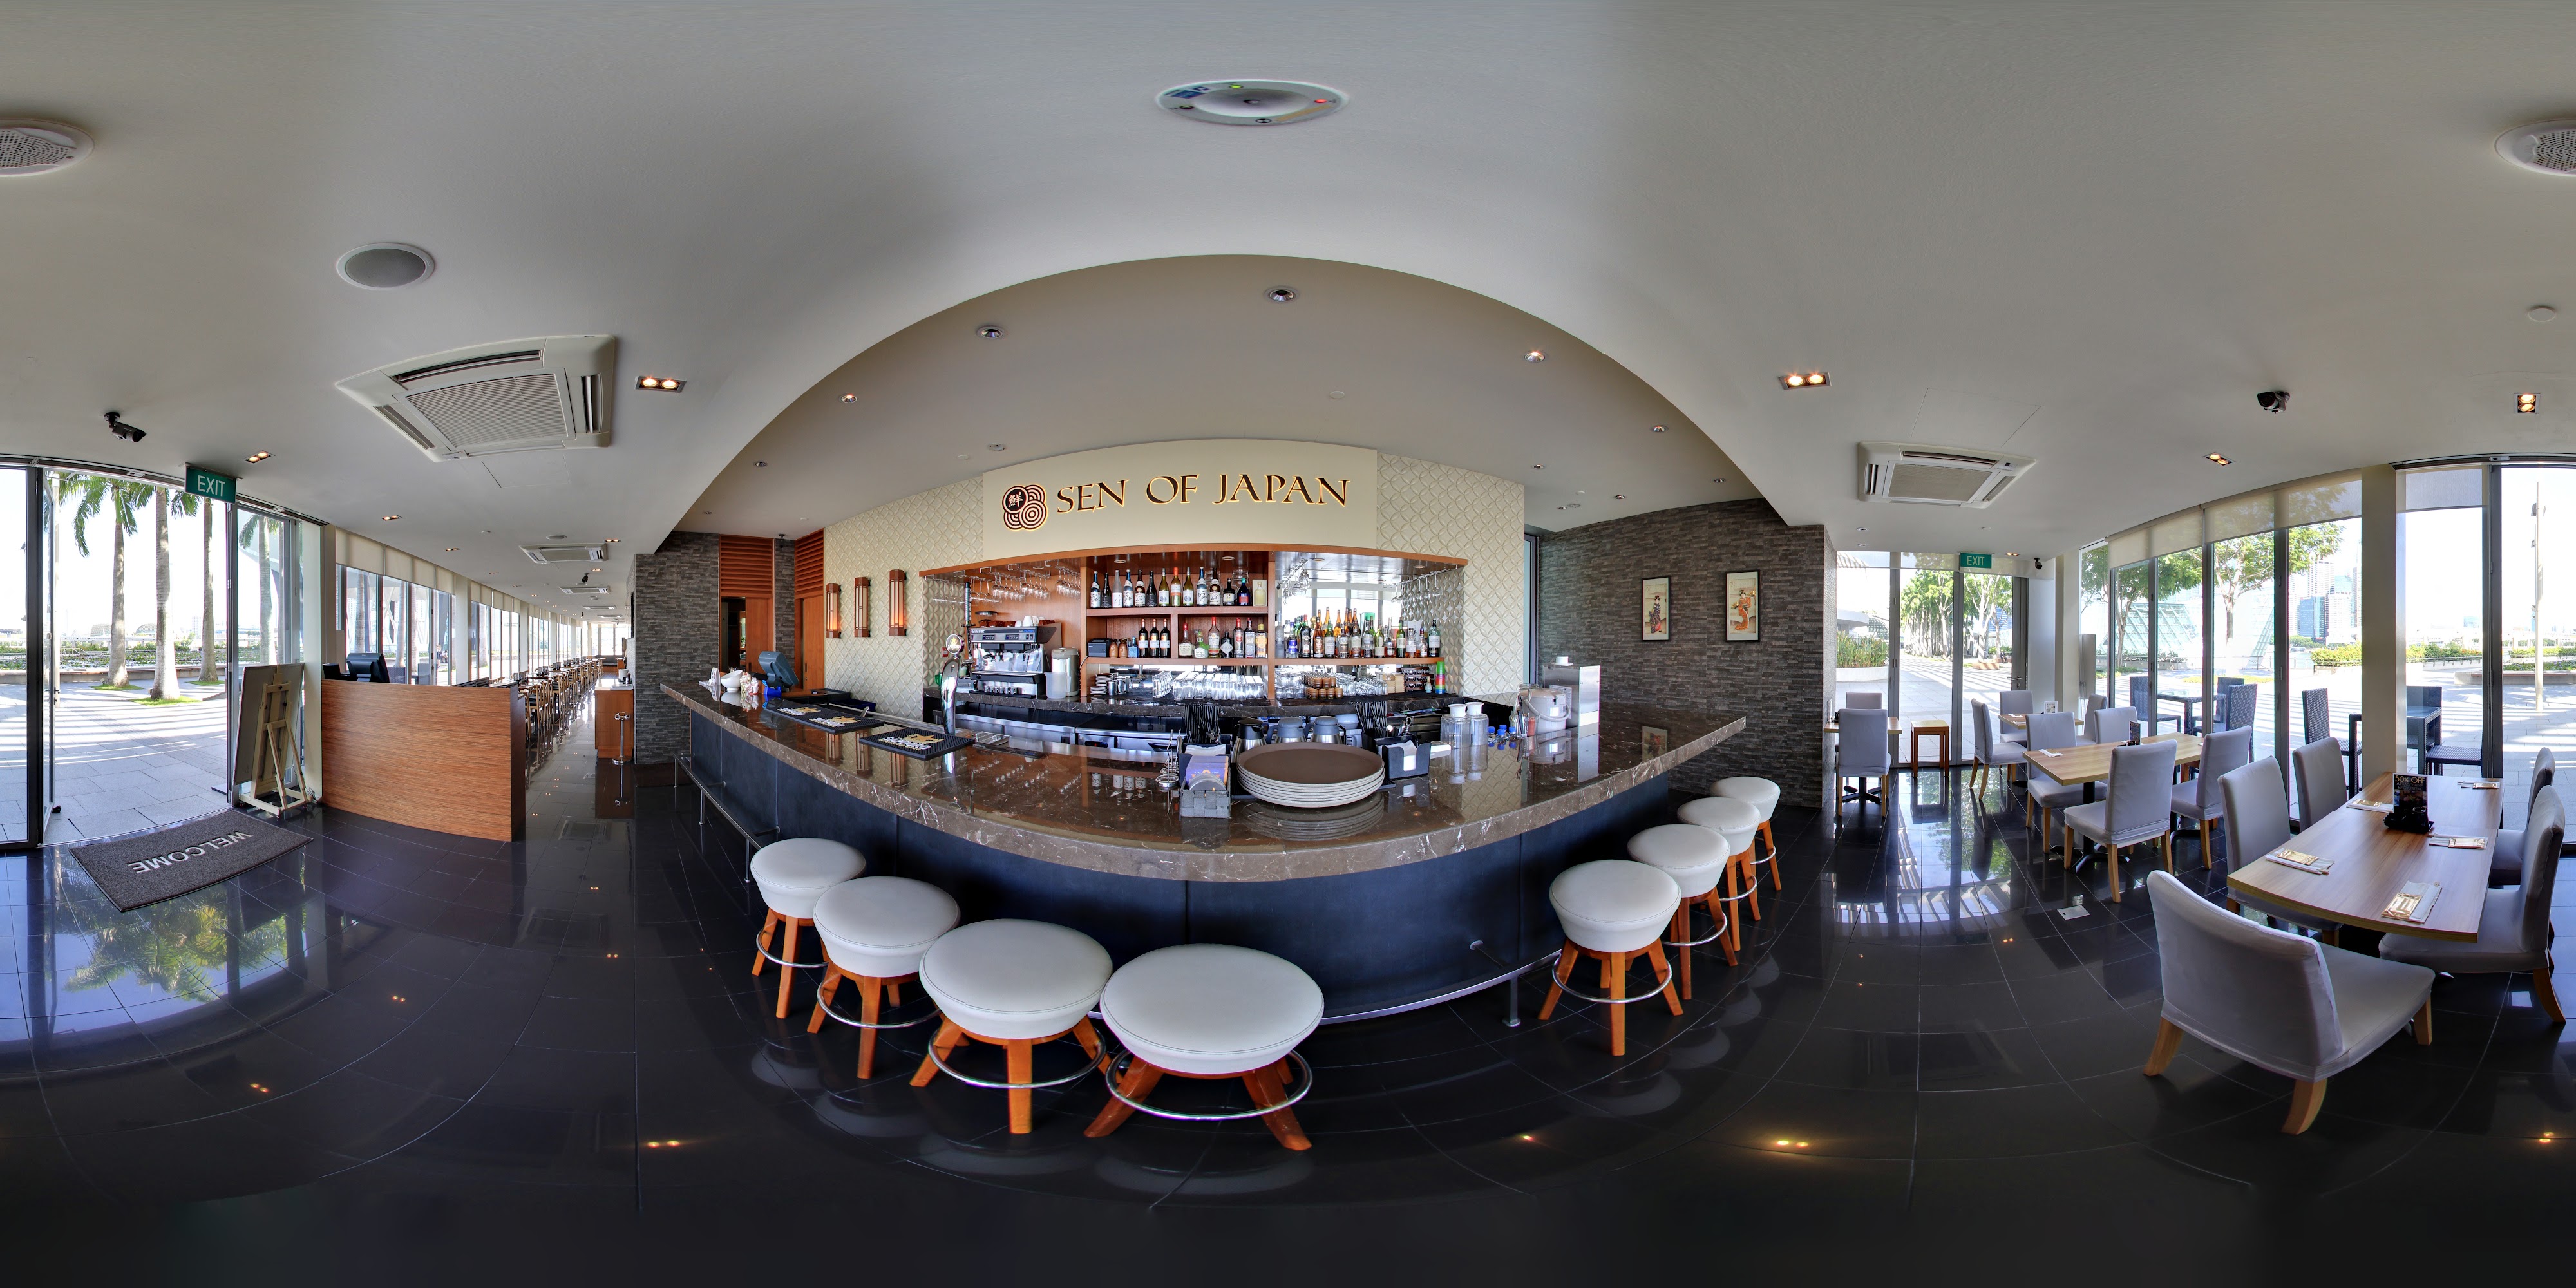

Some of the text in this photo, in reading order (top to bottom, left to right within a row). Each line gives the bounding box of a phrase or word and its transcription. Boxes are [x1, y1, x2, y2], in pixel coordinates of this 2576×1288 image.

[197, 475, 226, 497] EXIT
[1057, 473, 1351, 514] SEN OF JAPAN
[1008, 491, 1024, 508] 鮮
[1967, 555, 1985, 566] EXIT
[128, 831, 254, 873] WELCOME
